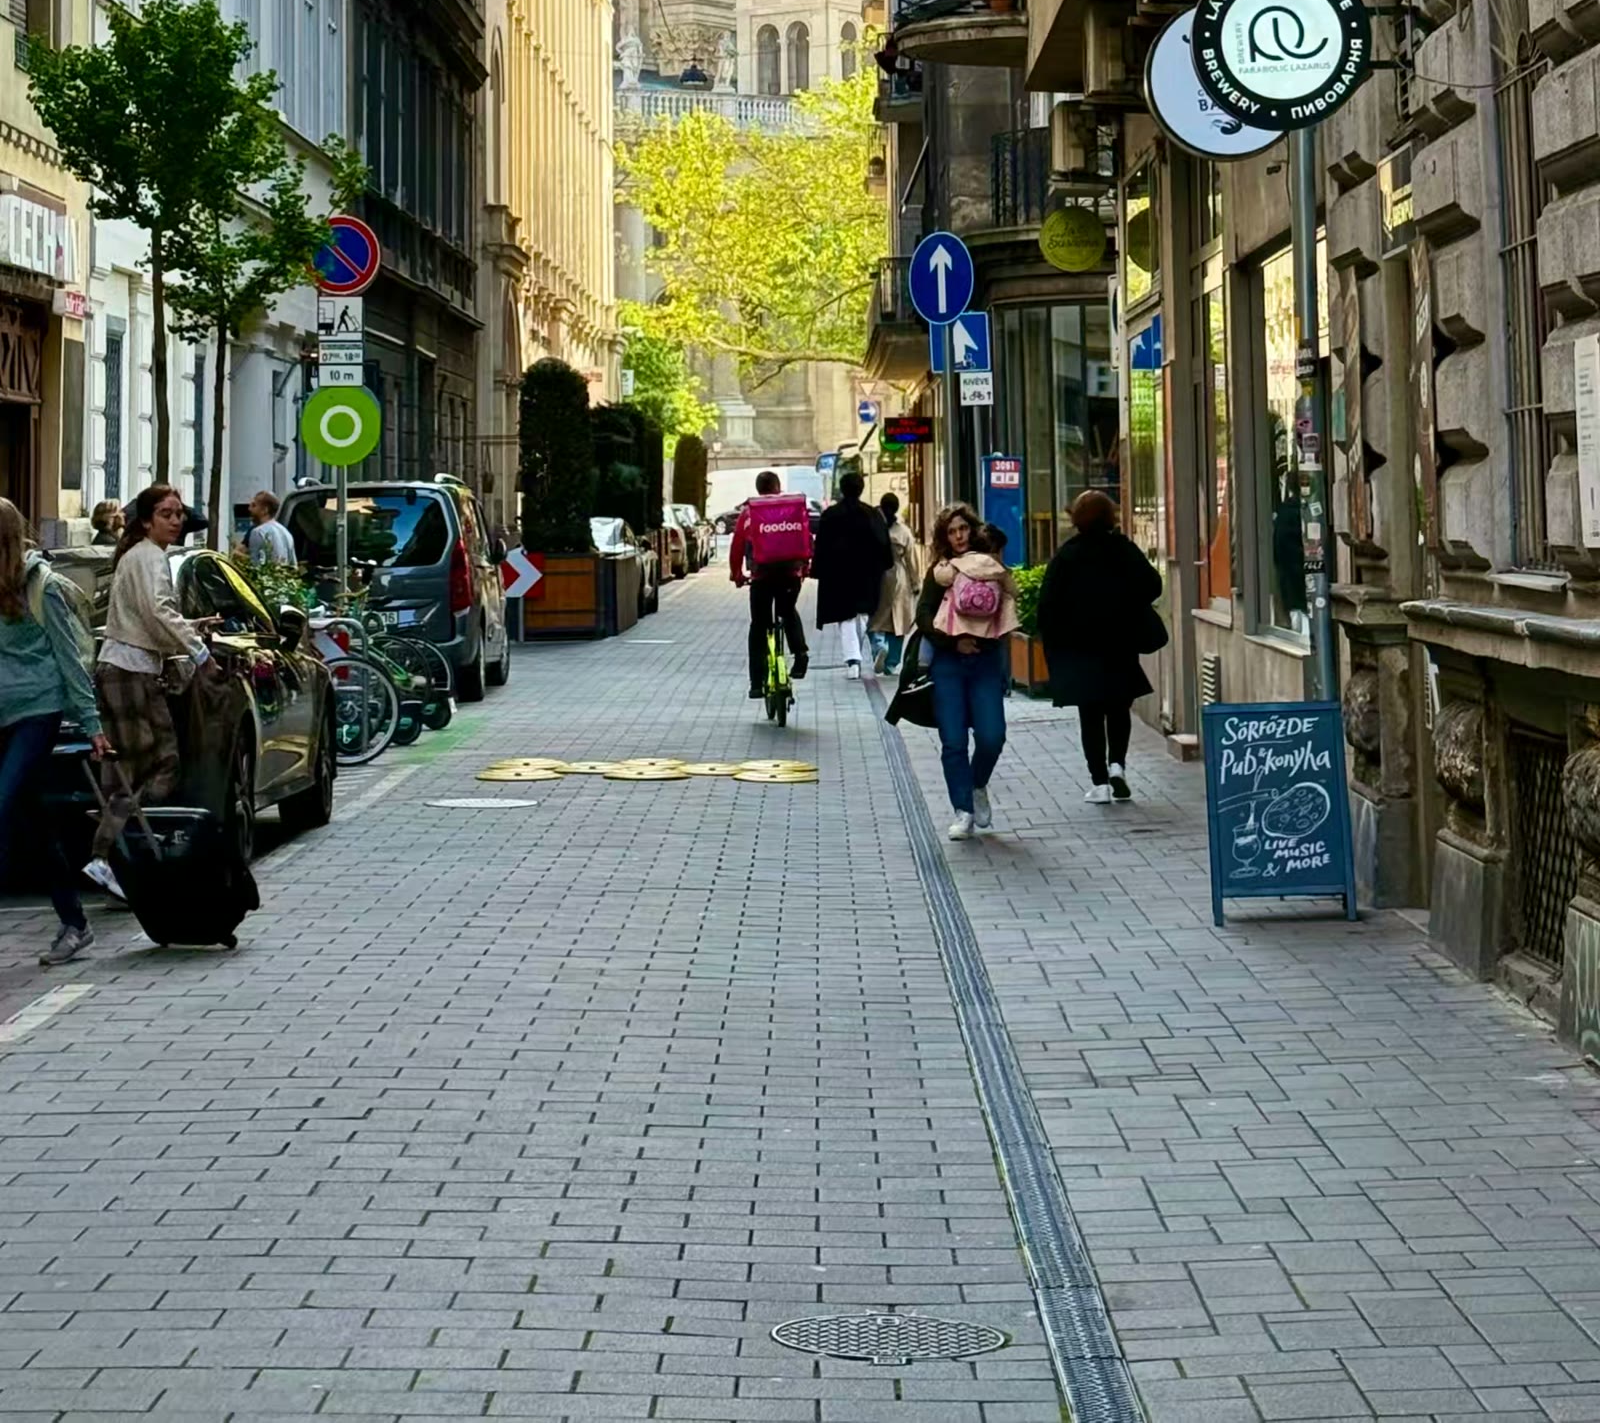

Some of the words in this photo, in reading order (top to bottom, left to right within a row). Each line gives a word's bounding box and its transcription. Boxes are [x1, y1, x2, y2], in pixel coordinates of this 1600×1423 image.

[1290, 61, 1331, 72] LAZARUS
[1202, 48, 1261, 115] BREWERY
[1291, 38, 1363, 119] ПИВОВАРНЯ
[329, 370, 341, 381] 10
[344, 373, 354, 381] m
[759, 520, 803, 534] foodora
[1220, 747, 1257, 785] Pub
[1264, 740, 1331, 777] konyha
[1264, 837, 1299, 850] LIVE
[1262, 862, 1281, 877] &
[1285, 853, 1332, 873] MORE
